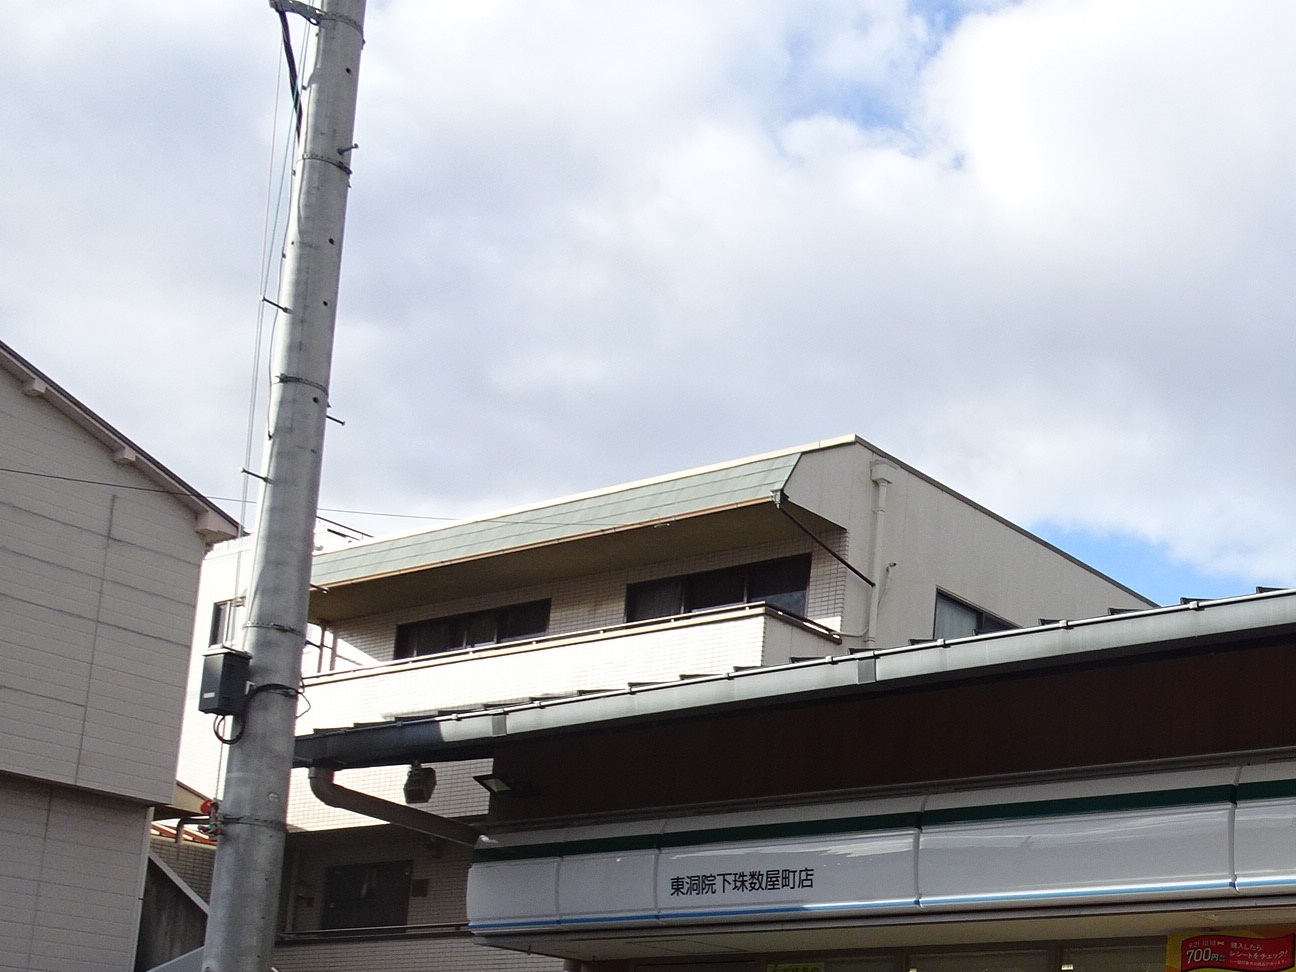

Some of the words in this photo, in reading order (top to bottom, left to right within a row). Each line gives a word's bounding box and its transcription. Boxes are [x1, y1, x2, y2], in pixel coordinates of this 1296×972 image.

[670, 867, 815, 897] 東洞院下珠数屋町店
